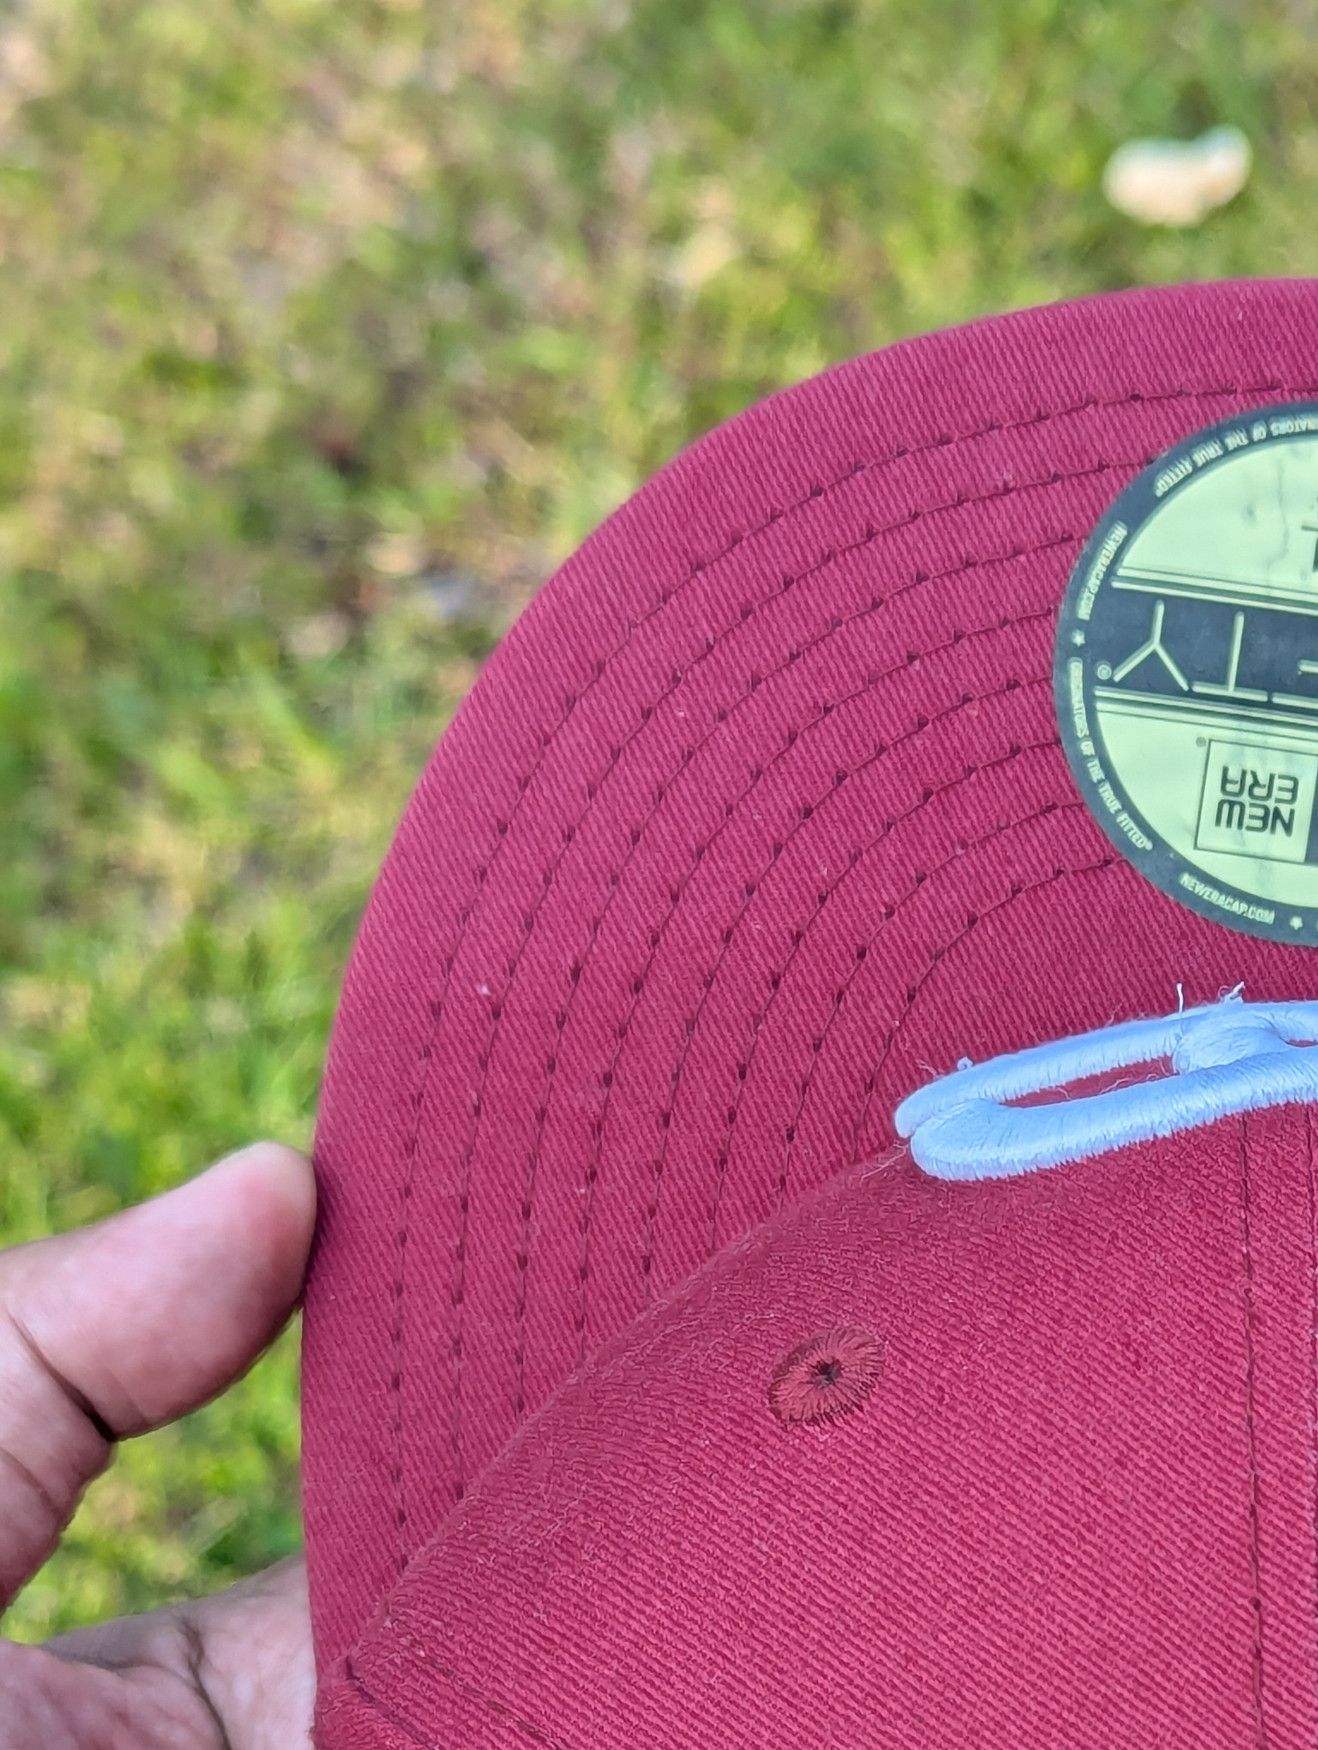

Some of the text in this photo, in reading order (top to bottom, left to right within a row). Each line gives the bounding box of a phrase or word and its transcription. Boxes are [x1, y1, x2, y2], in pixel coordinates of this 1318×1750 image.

[1252, 419, 1267, 442] OF
[1220, 765, 1300, 805] ERA
[1214, 798, 1296, 837] NEW
